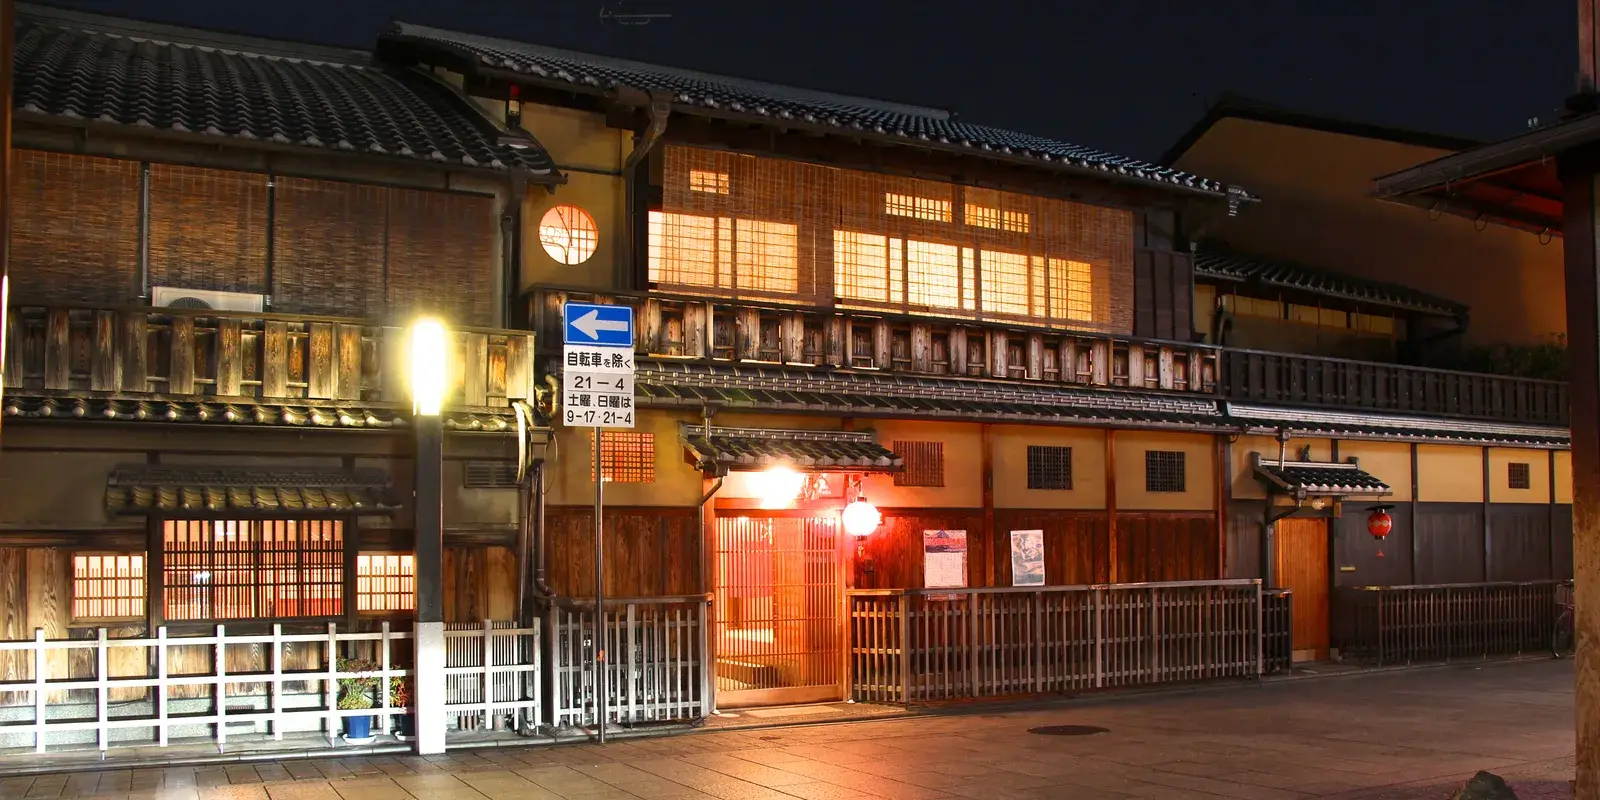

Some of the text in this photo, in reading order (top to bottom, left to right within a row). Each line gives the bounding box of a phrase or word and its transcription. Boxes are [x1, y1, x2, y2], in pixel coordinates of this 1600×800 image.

[567, 351, 631, 368] 自転車を除く
[568, 394, 631, 408] 土曜、日曜は
